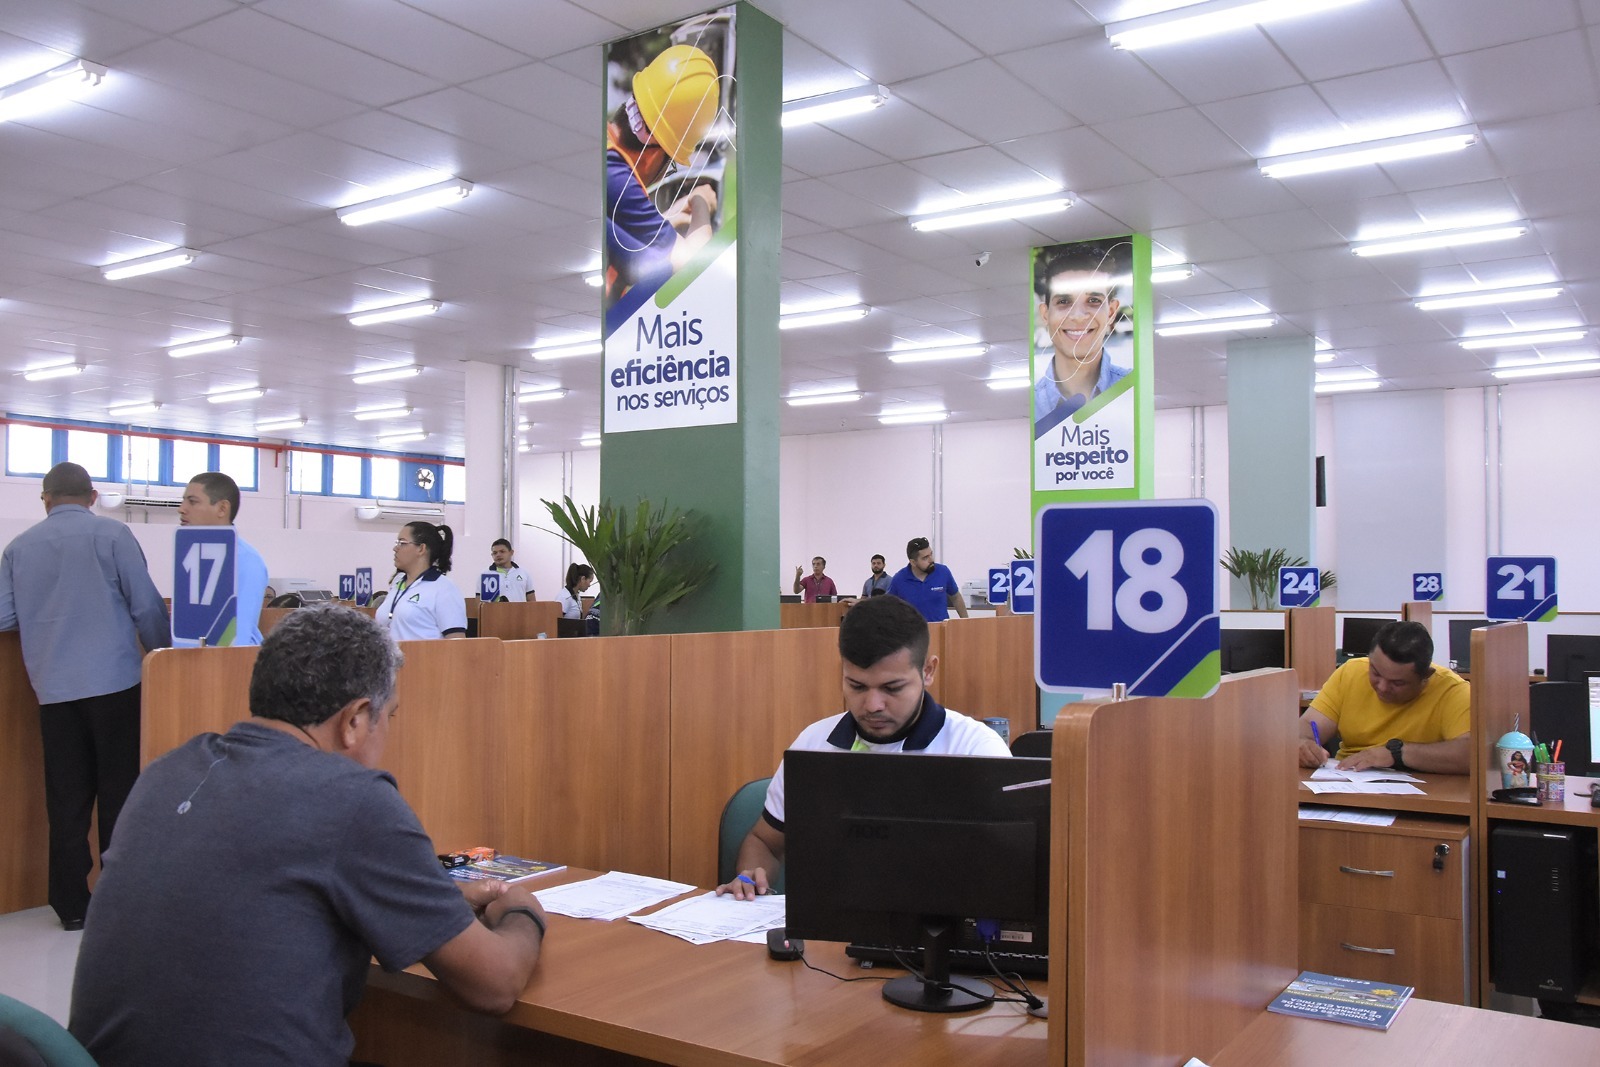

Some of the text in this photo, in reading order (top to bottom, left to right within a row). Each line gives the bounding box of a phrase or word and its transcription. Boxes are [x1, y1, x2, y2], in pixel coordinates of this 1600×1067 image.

[636, 311, 703, 352] Mais
[611, 350, 730, 388] eficiência
[617, 383, 730, 411] nos serviços
[1061, 424, 1110, 447] Mais
[1045, 446, 1129, 470] respeito
[1056, 467, 1115, 484] por você
[182, 542, 227, 606] 17
[343, 577, 352, 592] 11
[356, 572, 371, 594] 05
[483, 576, 498, 593] 10
[1064, 527, 1188, 634] 18
[1282, 572, 1316, 595] 24
[1415, 576, 1440, 593] 28
[1496, 564, 1546, 600] 21
